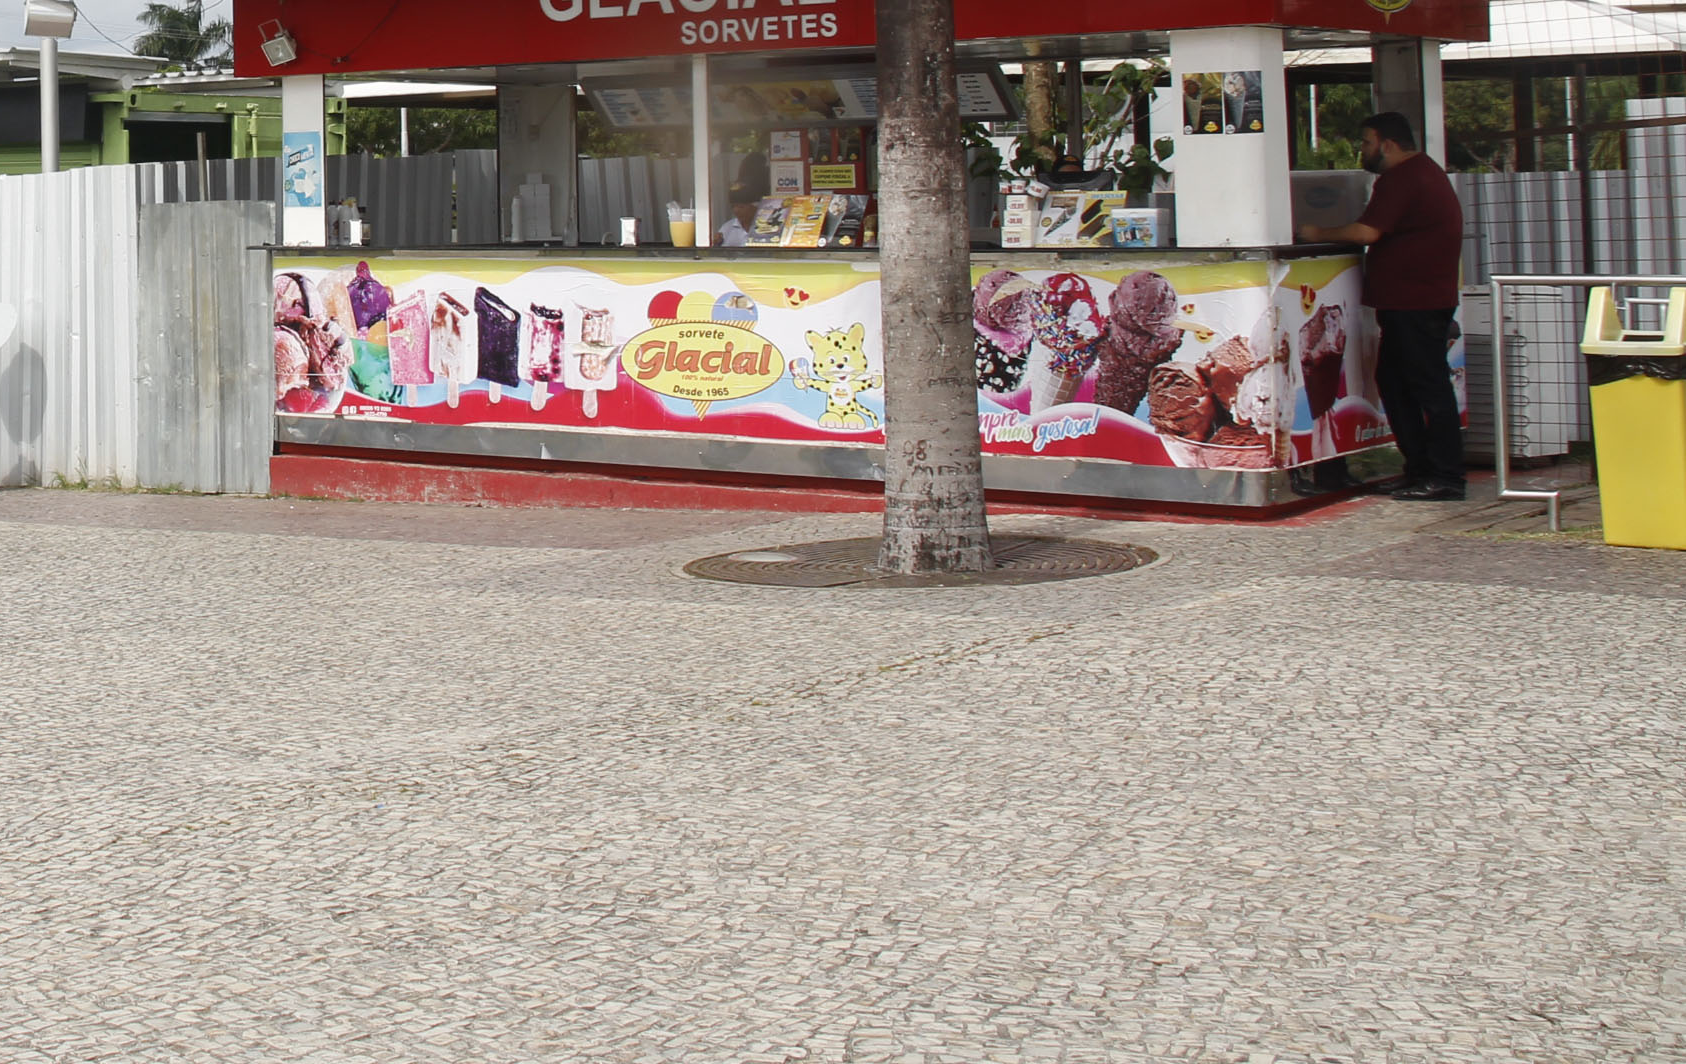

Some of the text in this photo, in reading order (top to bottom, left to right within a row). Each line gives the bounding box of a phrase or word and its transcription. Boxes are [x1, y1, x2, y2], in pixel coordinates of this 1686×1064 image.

[680, 12, 838, 45] SORVETES
[678, 329, 725, 340] sorvete
[634, 340, 773, 380] Glacial
[673, 385, 730, 397] Desde 1965
[978, 407, 1100, 451] mpre mais gostosa!
